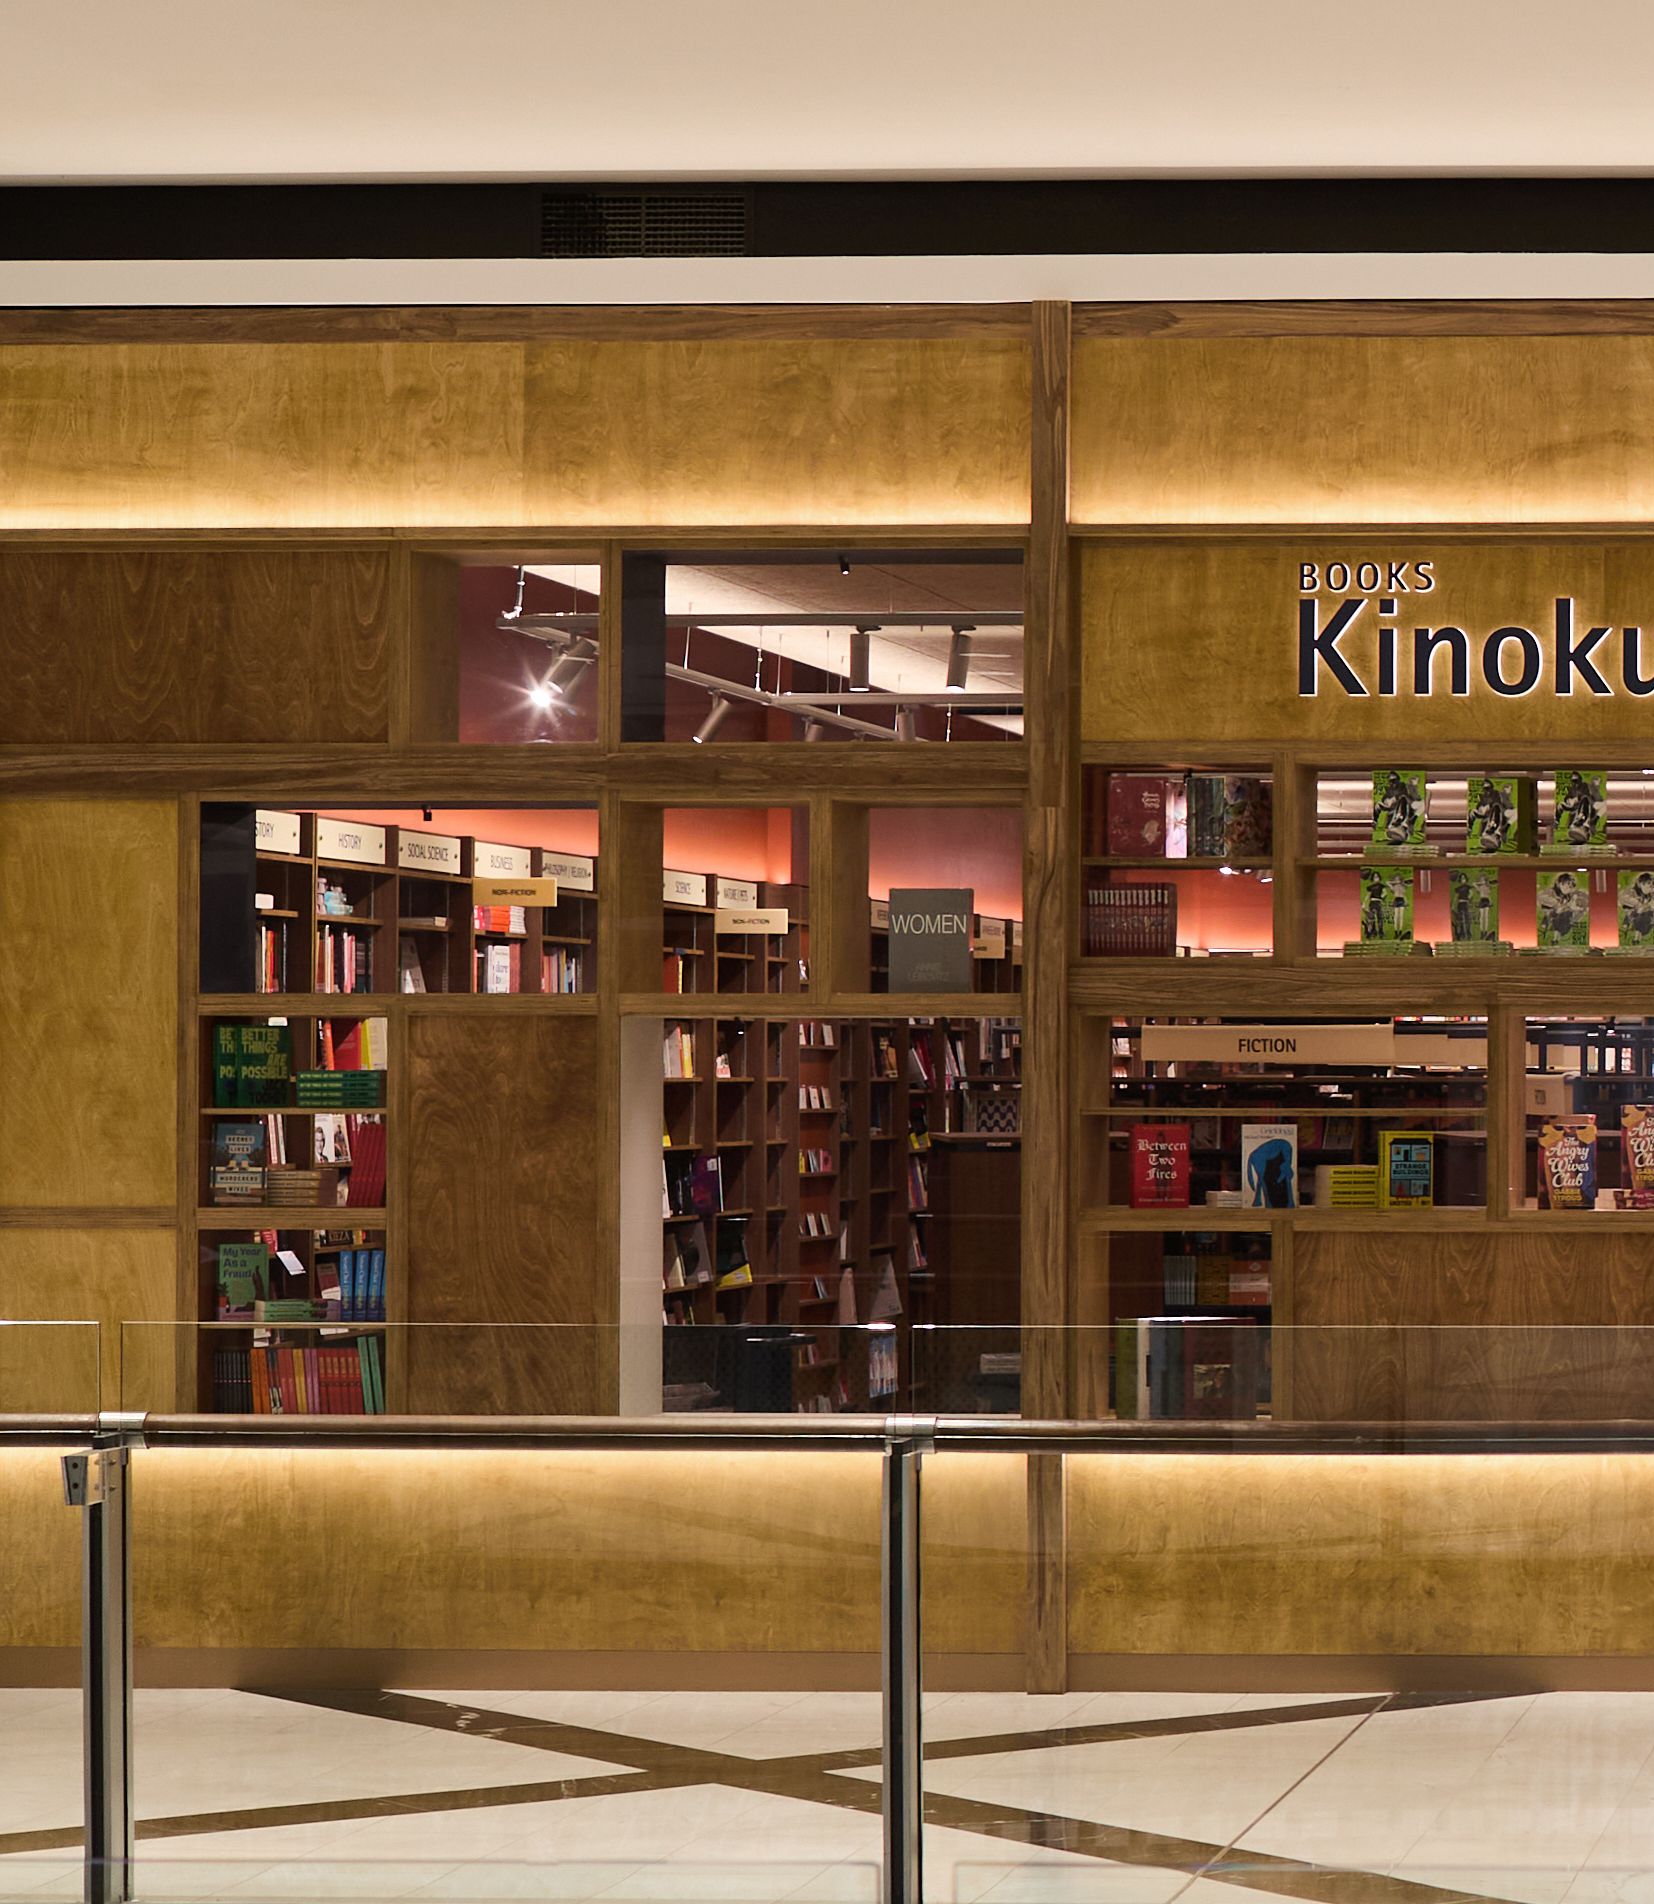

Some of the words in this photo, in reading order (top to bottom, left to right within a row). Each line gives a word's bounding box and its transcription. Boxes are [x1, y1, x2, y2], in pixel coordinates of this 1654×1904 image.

[1300, 562, 1436, 593] BOOKS
[338, 832, 362, 849] HISTORY
[408, 842, 426, 859] SOCIAL
[427, 845, 449, 862] SCIENCE
[891, 913, 967, 934] WOMEN
[241, 1027, 280, 1041] BETTER
[241, 1041, 278, 1054] THINGS
[1238, 1038, 1297, 1053] FICTION
[1137, 1139, 1187, 1151] Between
[1545, 1141, 1590, 1161] Angry
[1148, 1153, 1176, 1166] Two
[1547, 1157, 1589, 1173] Wives
[1145, 1167, 1178, 1181] Fires
[1552, 1172, 1584, 1188] Club
[223, 1247, 238, 1258] My
[239, 1247, 260, 1256] Year
[223, 1259, 239, 1268] As
[240, 1260, 247, 1268] a
